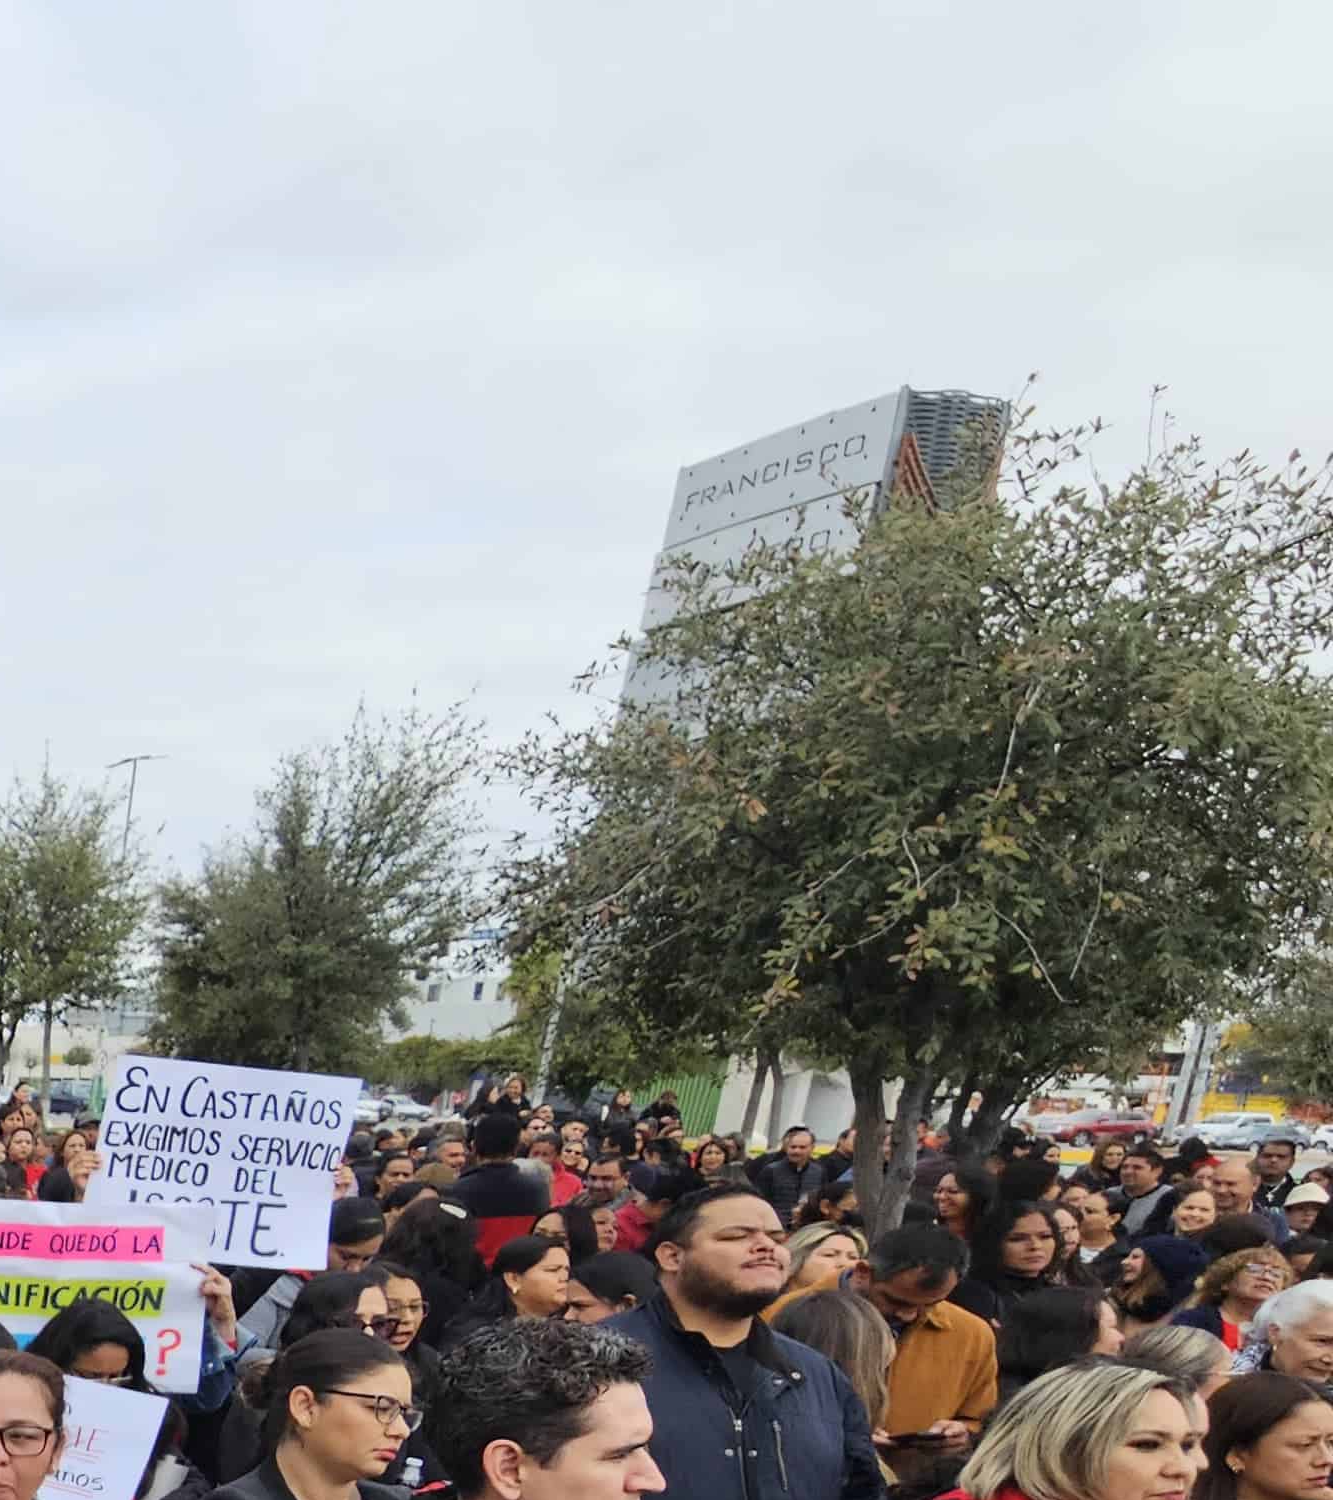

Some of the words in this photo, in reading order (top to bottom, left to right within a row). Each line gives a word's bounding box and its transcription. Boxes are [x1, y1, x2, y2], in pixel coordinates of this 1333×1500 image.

[685, 434, 866, 513] FRANCISCO
[104, 1121, 221, 1155] EXIGIMOS
[108, 1152, 209, 1187] MEDICO
[234, 1167, 283, 1197] DEL
[49, 1229, 119, 1255] QUEDÓ
[133, 1235, 162, 1255] LA
